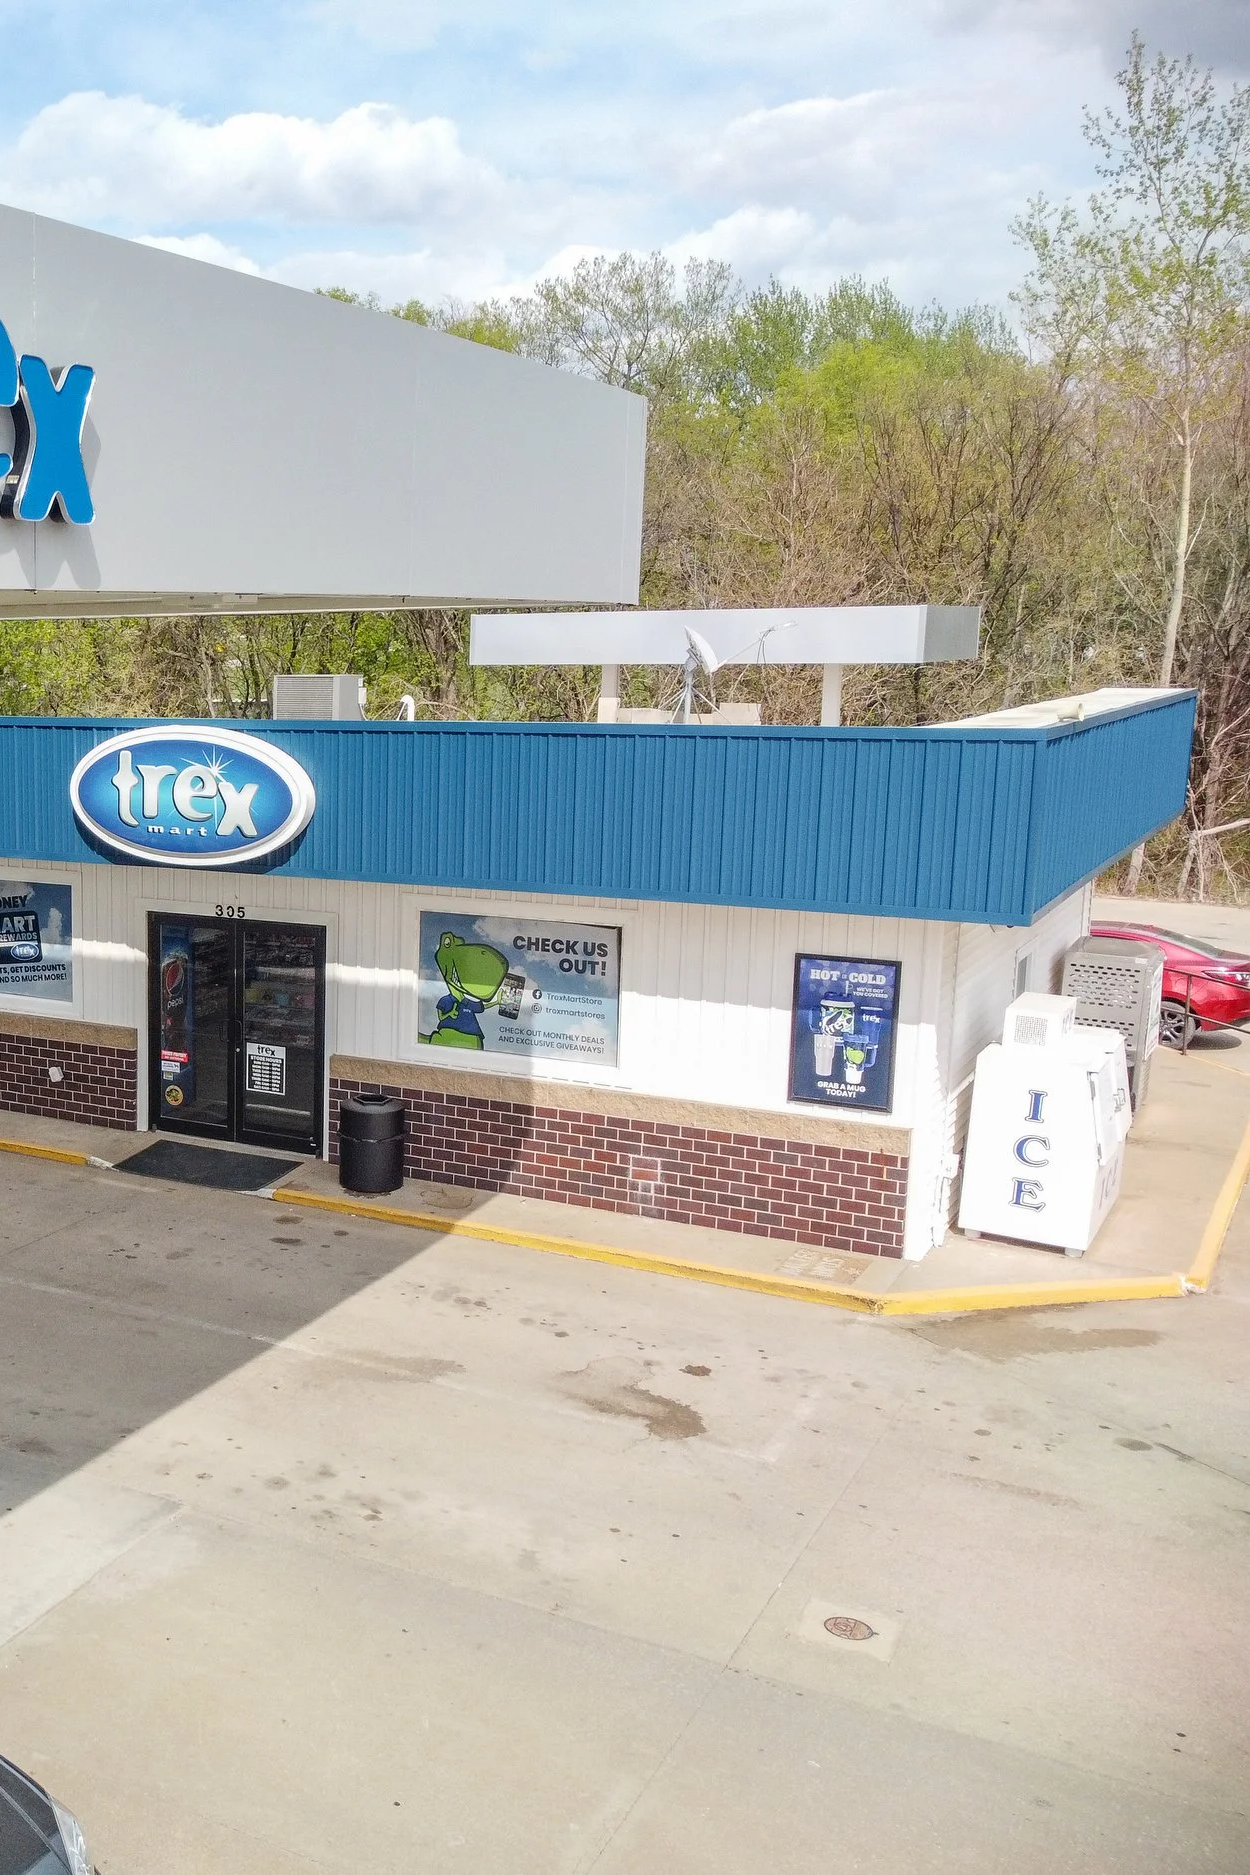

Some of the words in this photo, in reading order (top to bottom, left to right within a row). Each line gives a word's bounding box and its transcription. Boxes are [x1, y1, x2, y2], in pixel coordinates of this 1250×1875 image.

[112, 750, 258, 838] trex
[147, 824, 207, 837] mart
[215, 904, 246, 919] 305
[513, 936, 579, 955] CHECK
[583, 941, 608, 957] US
[10, 966, 23, 974] GET
[25, 964, 66, 973] DISCOUNTS
[559, 958, 607, 976] OUT!
[21, 974, 43, 982] MUCH
[44, 973, 67, 981] MORE!
[810, 969, 840, 981] HOT
[849, 972, 886, 985] COLD
[499, 1026, 525, 1036] CHECK
[526, 1029, 542, 1037] OUT
[542, 1031, 579, 1041] MONTHLY
[581, 1035, 605, 1045] DEALS
[257, 1045, 275, 1056] trex
[498, 1035, 514, 1043] AND
[515, 1038, 554, 1048] EXCLUSIVE
[556, 1042, 605, 1054] GIVEAWAYS!
[818, 1081, 840, 1090] GRAB
[847, 1084, 866, 1092] MUG
[826, 1088, 856, 1098] TODAY!
[1008, 1089, 1050, 1213] ICE
